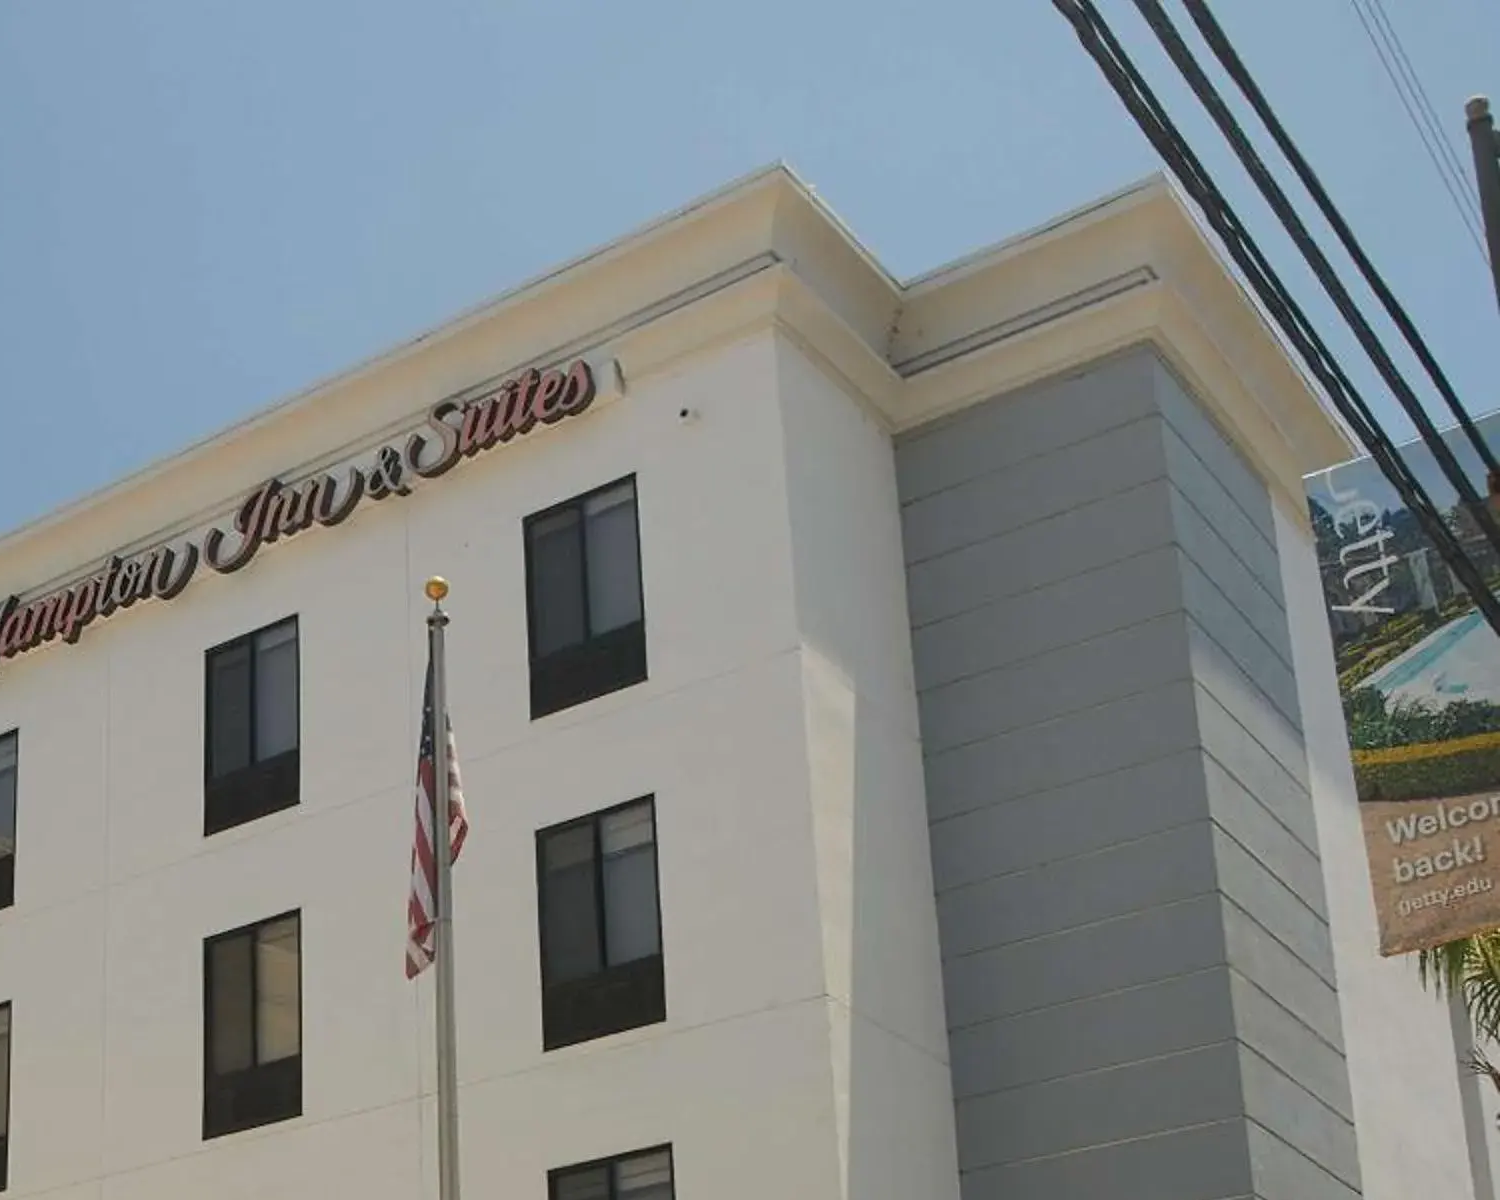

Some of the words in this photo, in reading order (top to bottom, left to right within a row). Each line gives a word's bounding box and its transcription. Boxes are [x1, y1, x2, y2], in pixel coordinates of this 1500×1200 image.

[202, 466, 365, 574] Inn
[365, 446, 412, 501] &
[405, 359, 597, 478] Suites
[1393, 835, 1485, 884] back!
[1399, 876, 1492, 916] getty.edu
